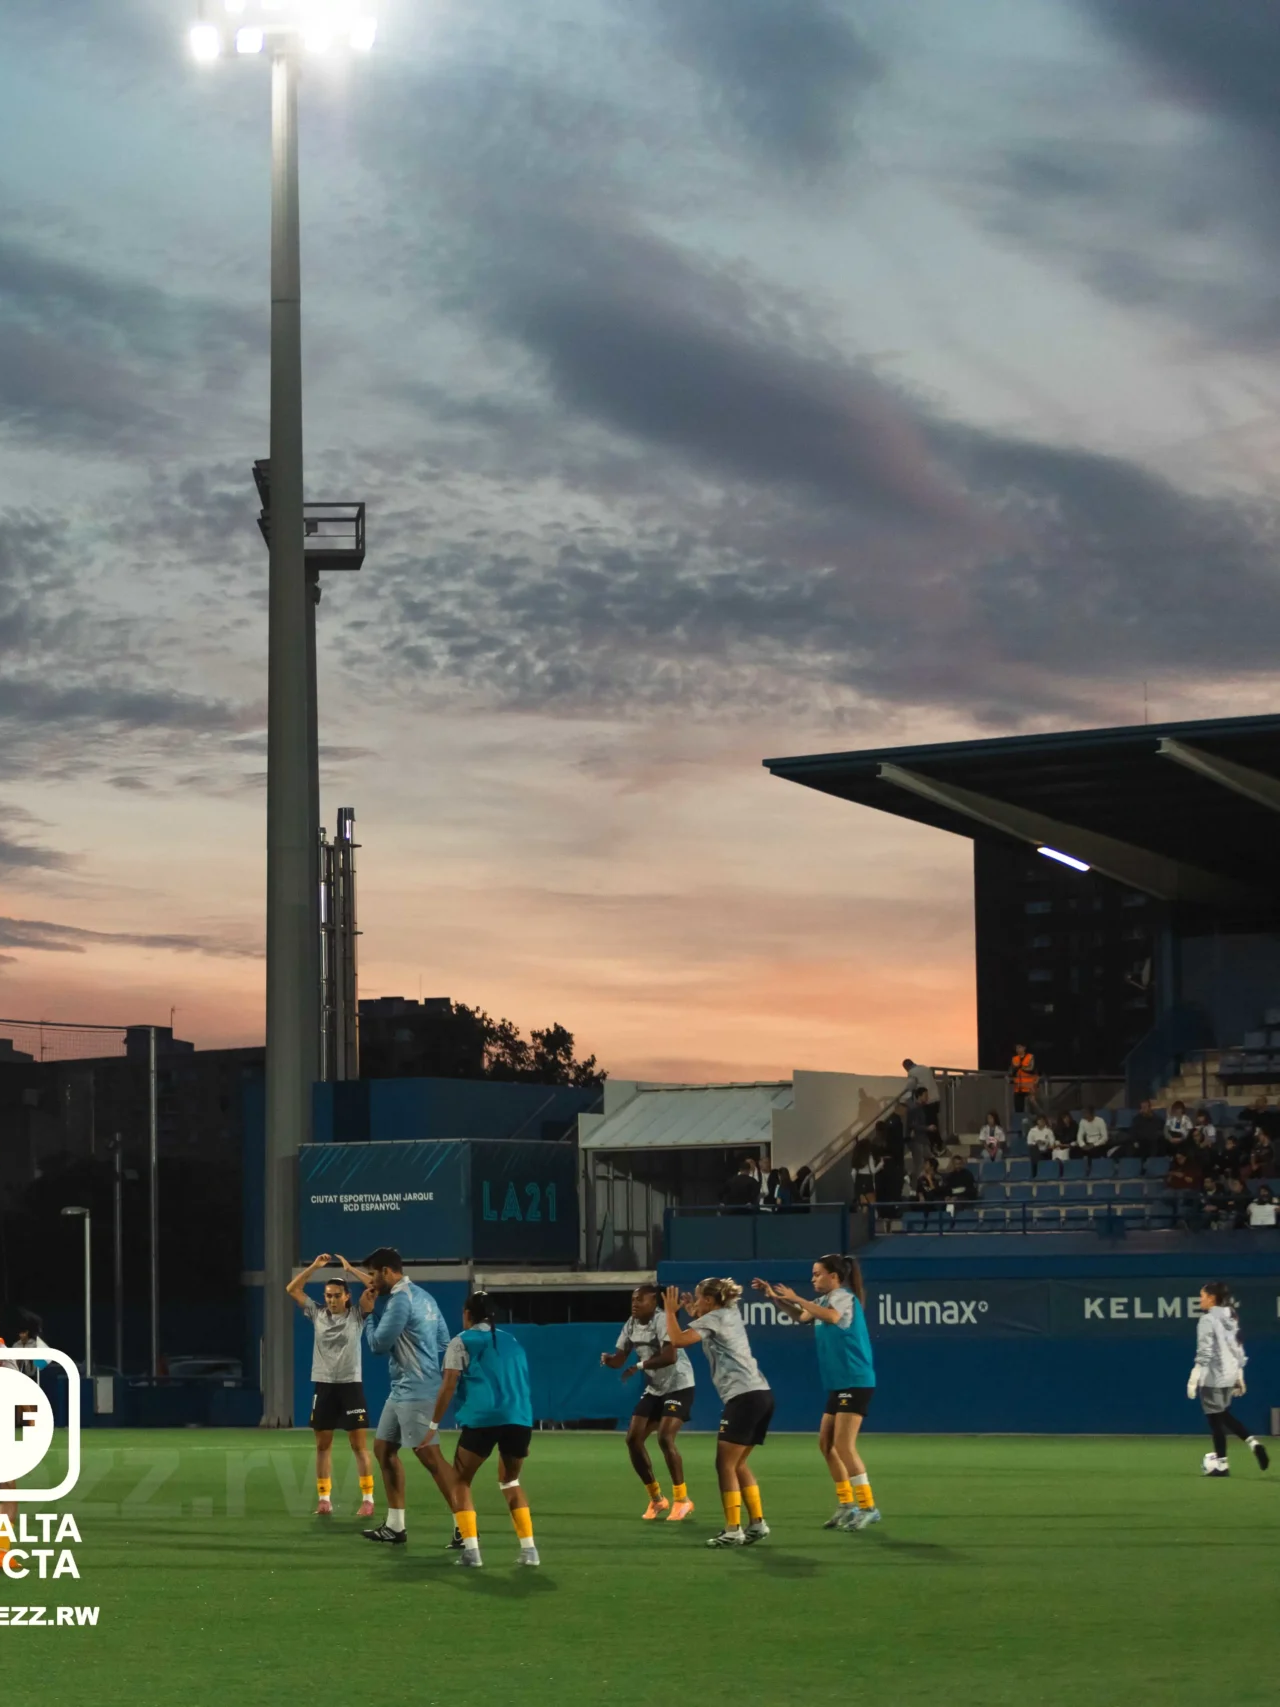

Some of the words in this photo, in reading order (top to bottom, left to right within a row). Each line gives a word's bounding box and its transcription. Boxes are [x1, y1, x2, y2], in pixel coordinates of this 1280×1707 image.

[310, 1195, 338, 1203] CIUTAT
[340, 1194, 380, 1203] ESPORTIVA
[382, 1193, 401, 1202] DANI
[403, 1192, 434, 1201] JARQUE
[343, 1203, 359, 1212] RCD
[361, 1202, 400, 1211] ESPANYOL
[482, 1181, 556, 1222] LA21
[879, 1294, 978, 1326] ilumax
[1084, 1297, 1207, 1319] KELME
